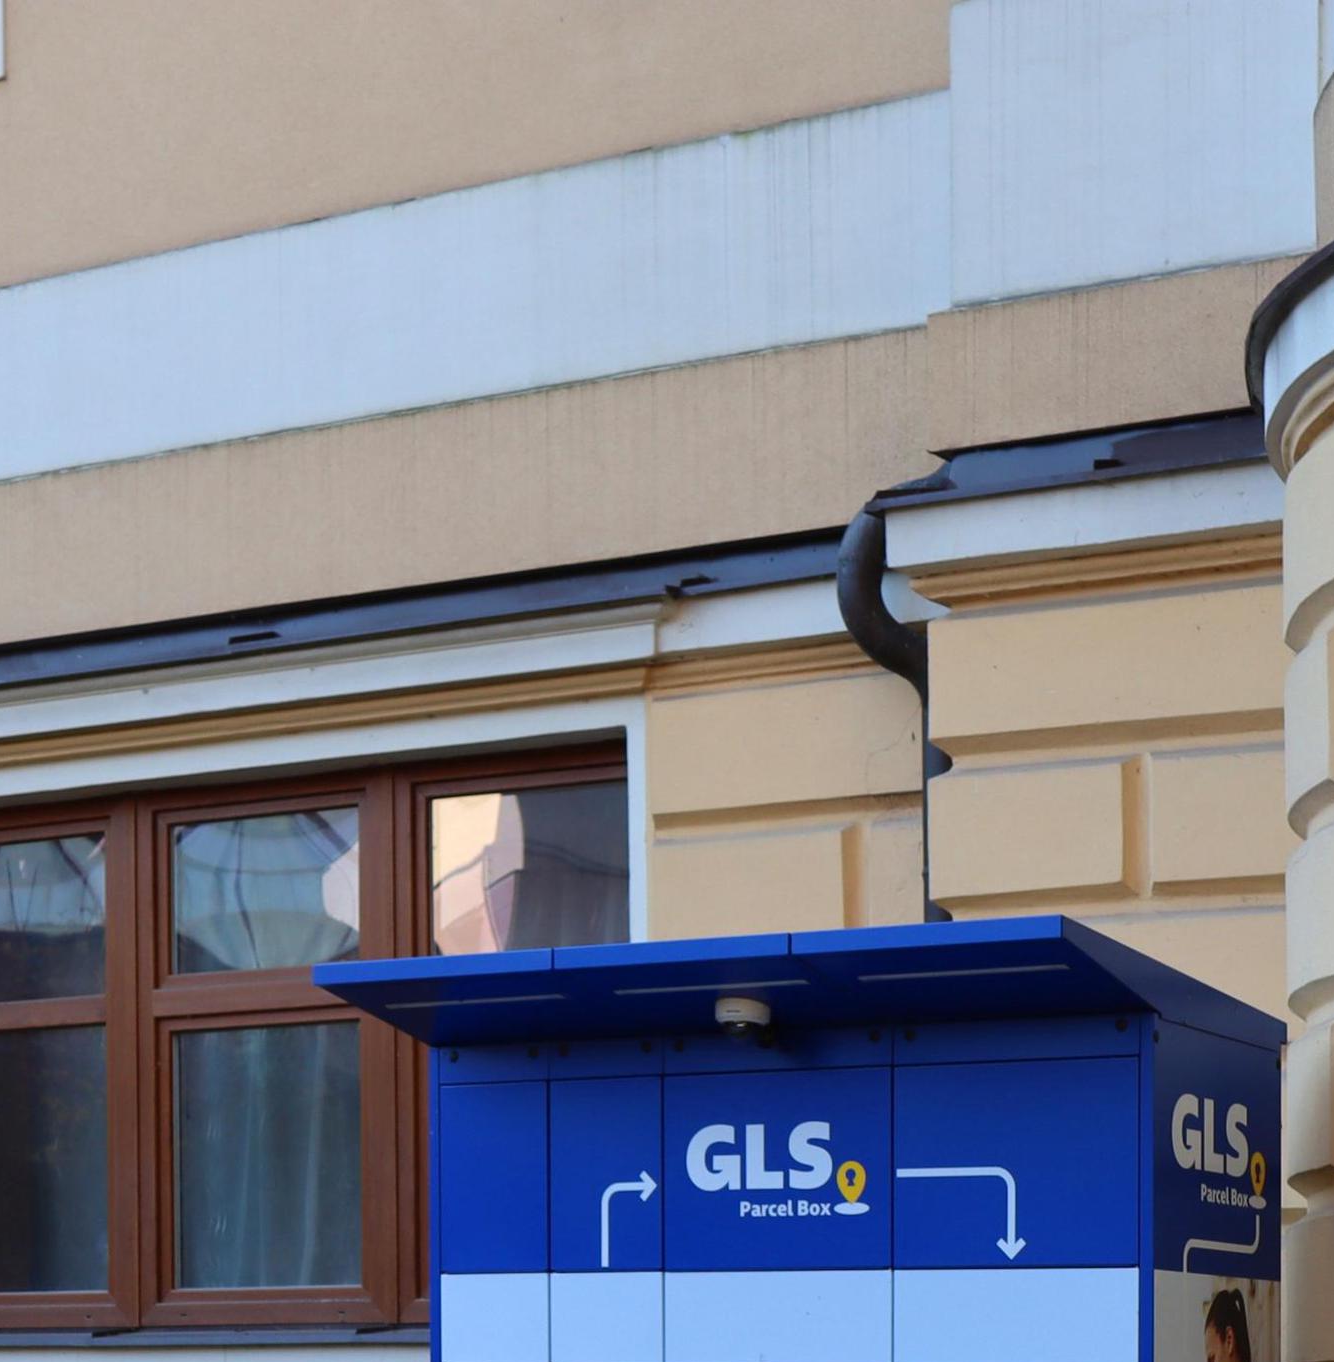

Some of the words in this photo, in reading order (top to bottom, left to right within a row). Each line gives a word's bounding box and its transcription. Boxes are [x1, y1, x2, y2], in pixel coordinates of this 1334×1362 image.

[686, 1121, 833, 1192] GLS
[1171, 1093, 1249, 1178] GLS
[739, 1200, 794, 1218] Parcel
[797, 1200, 832, 1217] Box
[1200, 1183, 1229, 1205] Parcel
[1230, 1187, 1249, 1208] Box
